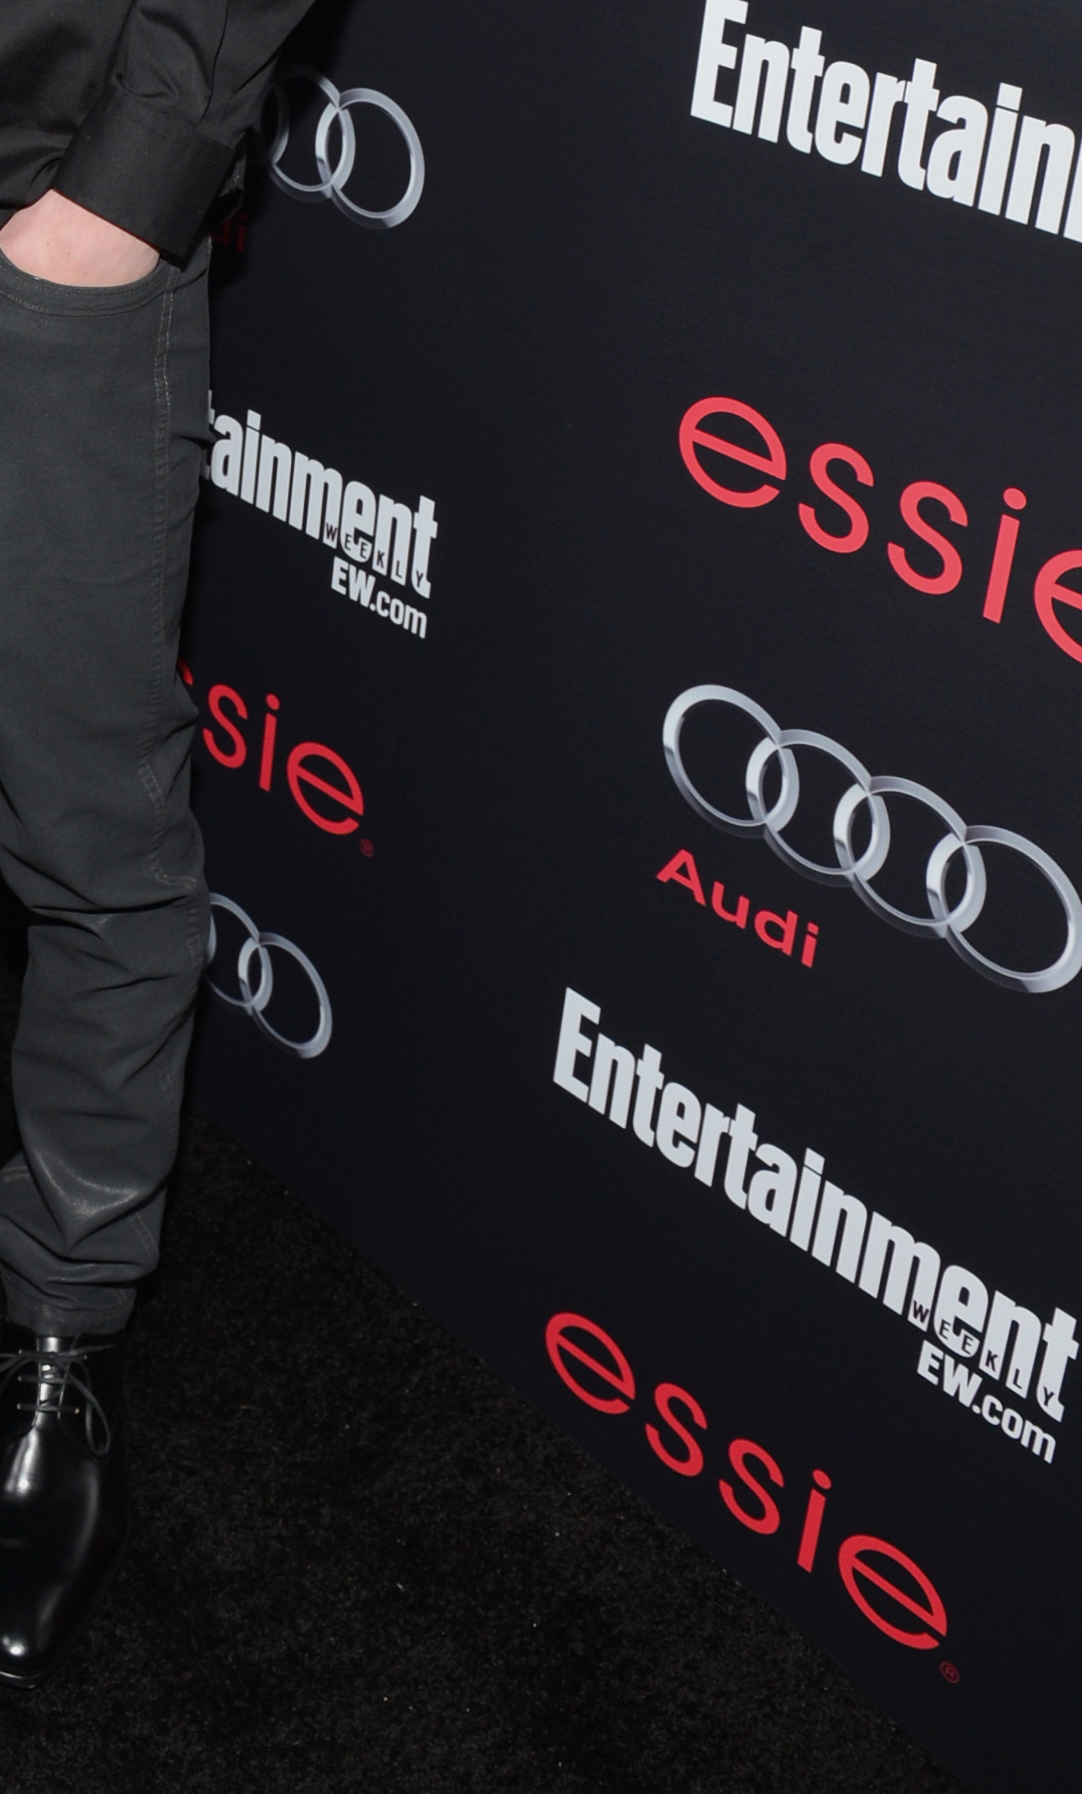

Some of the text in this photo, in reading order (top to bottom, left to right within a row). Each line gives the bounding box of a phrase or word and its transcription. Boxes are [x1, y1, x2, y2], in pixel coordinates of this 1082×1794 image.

[331, 556, 428, 639] EW.com
[178, 657, 364, 835] sie
[656, 848, 820, 968] Audi
[553, 987, 1079, 1421] Entertainment
[917, 1339, 1057, 1463] EW.com
[544, 1311, 948, 1651] essie
